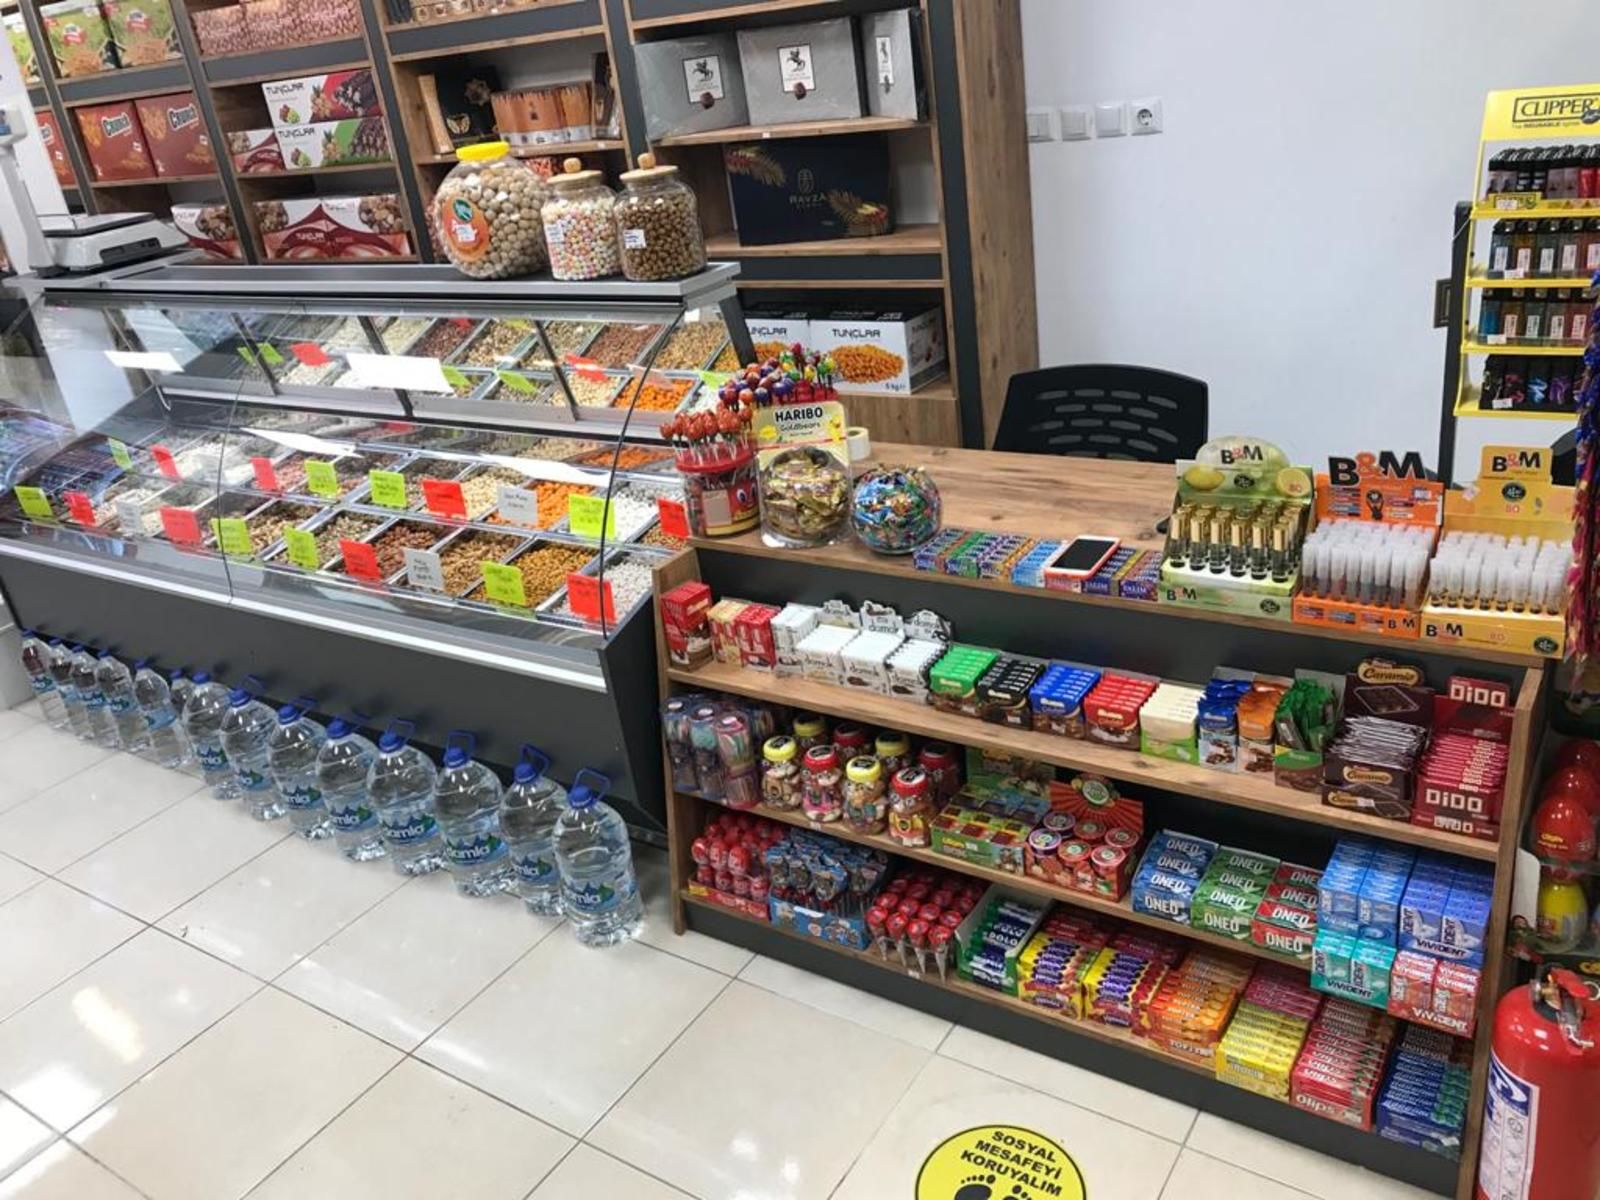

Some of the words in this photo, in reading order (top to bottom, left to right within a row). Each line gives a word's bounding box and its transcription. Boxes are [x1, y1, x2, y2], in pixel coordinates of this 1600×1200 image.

[1521, 98, 1594, 117] CLIPPER
[832, 328, 880, 339] TUNÇLAR
[775, 407, 823, 422] HARIBO
[1220, 445, 1263, 465] B&M
[1491, 450, 1541, 472] B&M
[1329, 449, 1426, 487] B&M
[992, 1130, 1057, 1163] SOSYAL
[975, 1140, 1063, 1180] MESAFEYİ
[960, 1150, 1063, 1197] KORUYALIM
